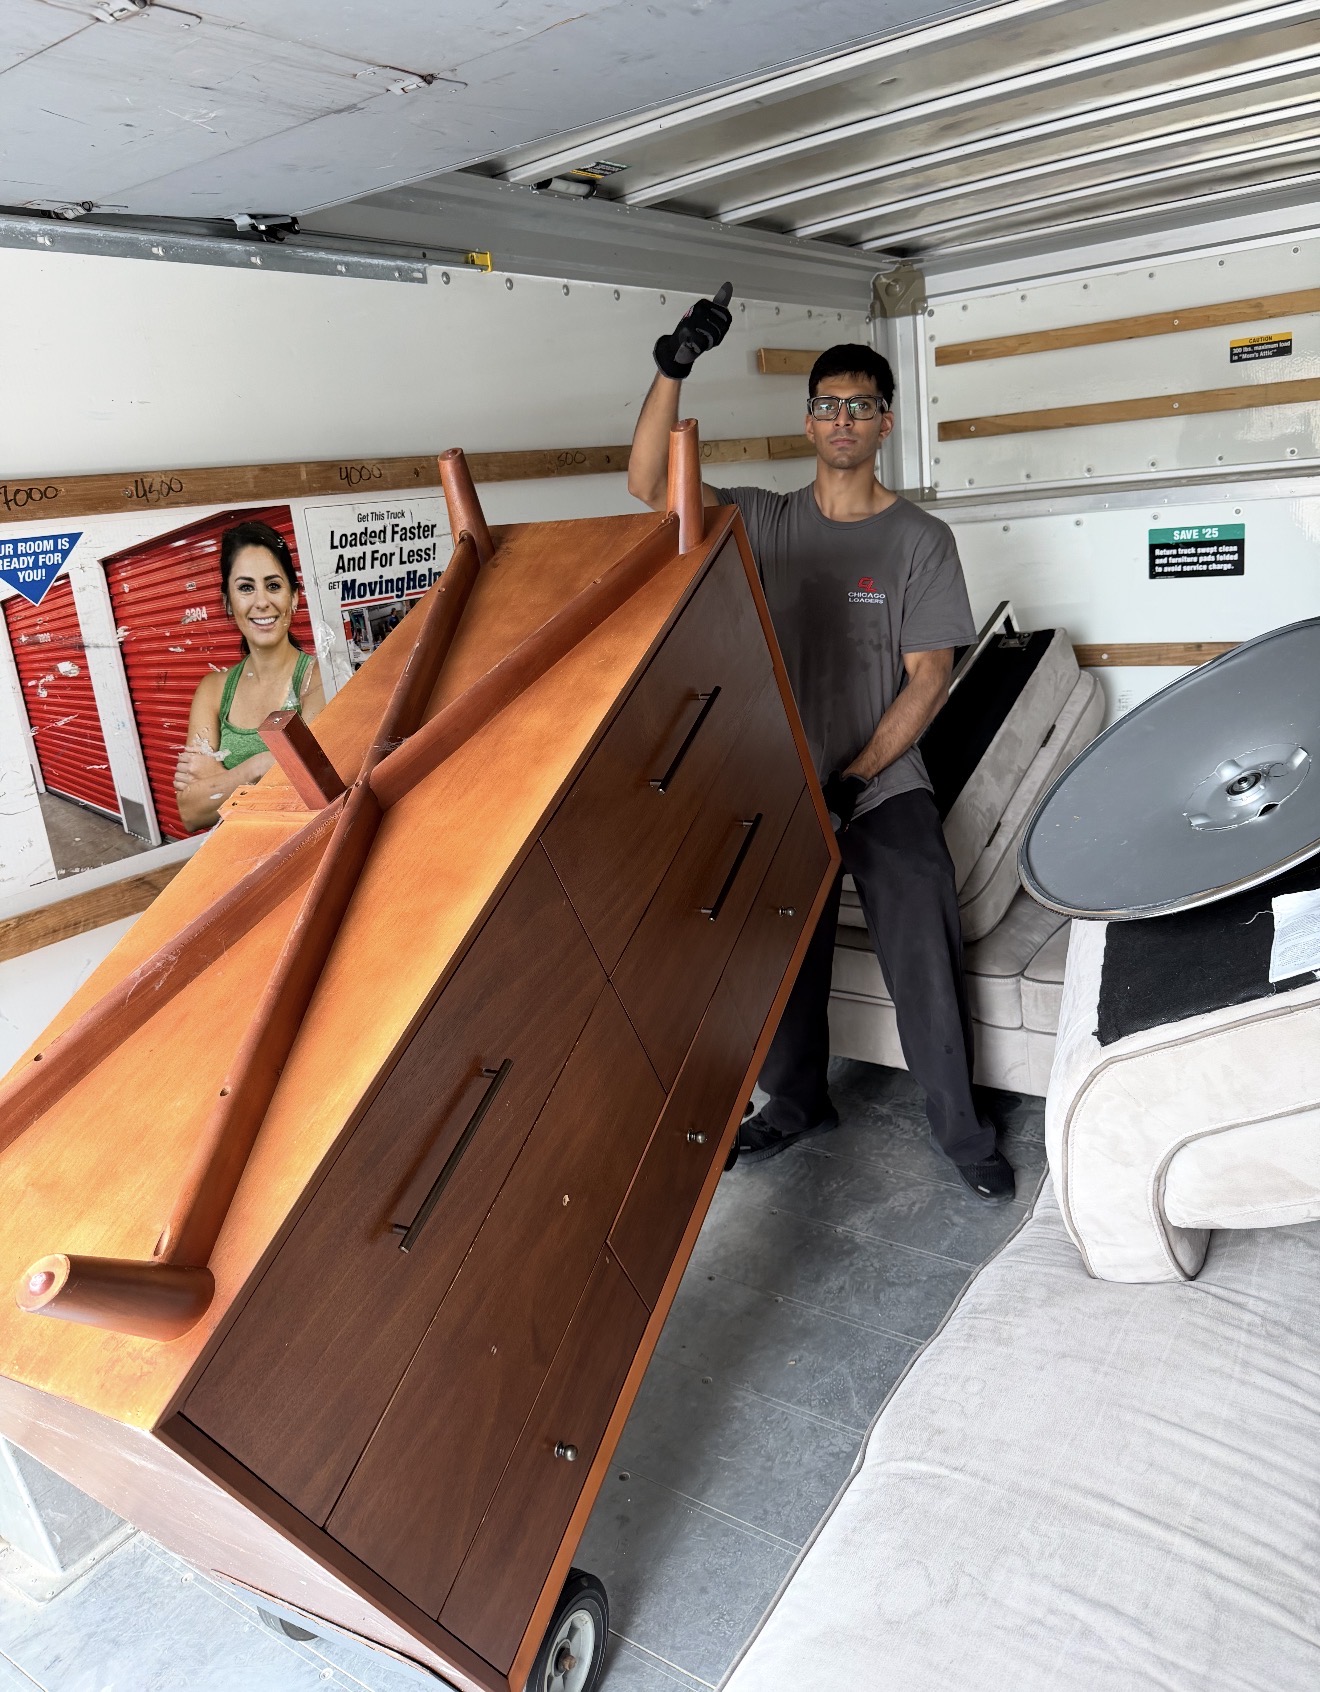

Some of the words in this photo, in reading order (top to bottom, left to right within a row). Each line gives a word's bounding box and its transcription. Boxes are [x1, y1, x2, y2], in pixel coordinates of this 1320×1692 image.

[1253, 342, 1279, 350] maximum
[339, 465, 383, 487] 4000
[357, 512, 369, 522] Get
[370, 511, 385, 521] This
[386, 509, 406, 520] Truck
[330, 525, 387, 550] Loaded
[391, 522, 437, 543] Faster
[1173, 529, 1199, 540] SAVE
[1202, 528, 1219, 538] $25
[18, 539, 53, 555] ROOM
[58, 538, 70, 550] IS
[1197, 546, 1217, 554] swept
[39, 553, 62, 566] FOR
[335, 551, 366, 574] And
[370, 549, 396, 569] For
[399, 542, 437, 566] Less!
[1216, 553, 1239, 561] folded
[1163, 564, 1182, 572] avoid
[1208, 562, 1235, 570] charge.
[17, 568, 46, 583] YOU!
[328, 581, 340, 590] GET
